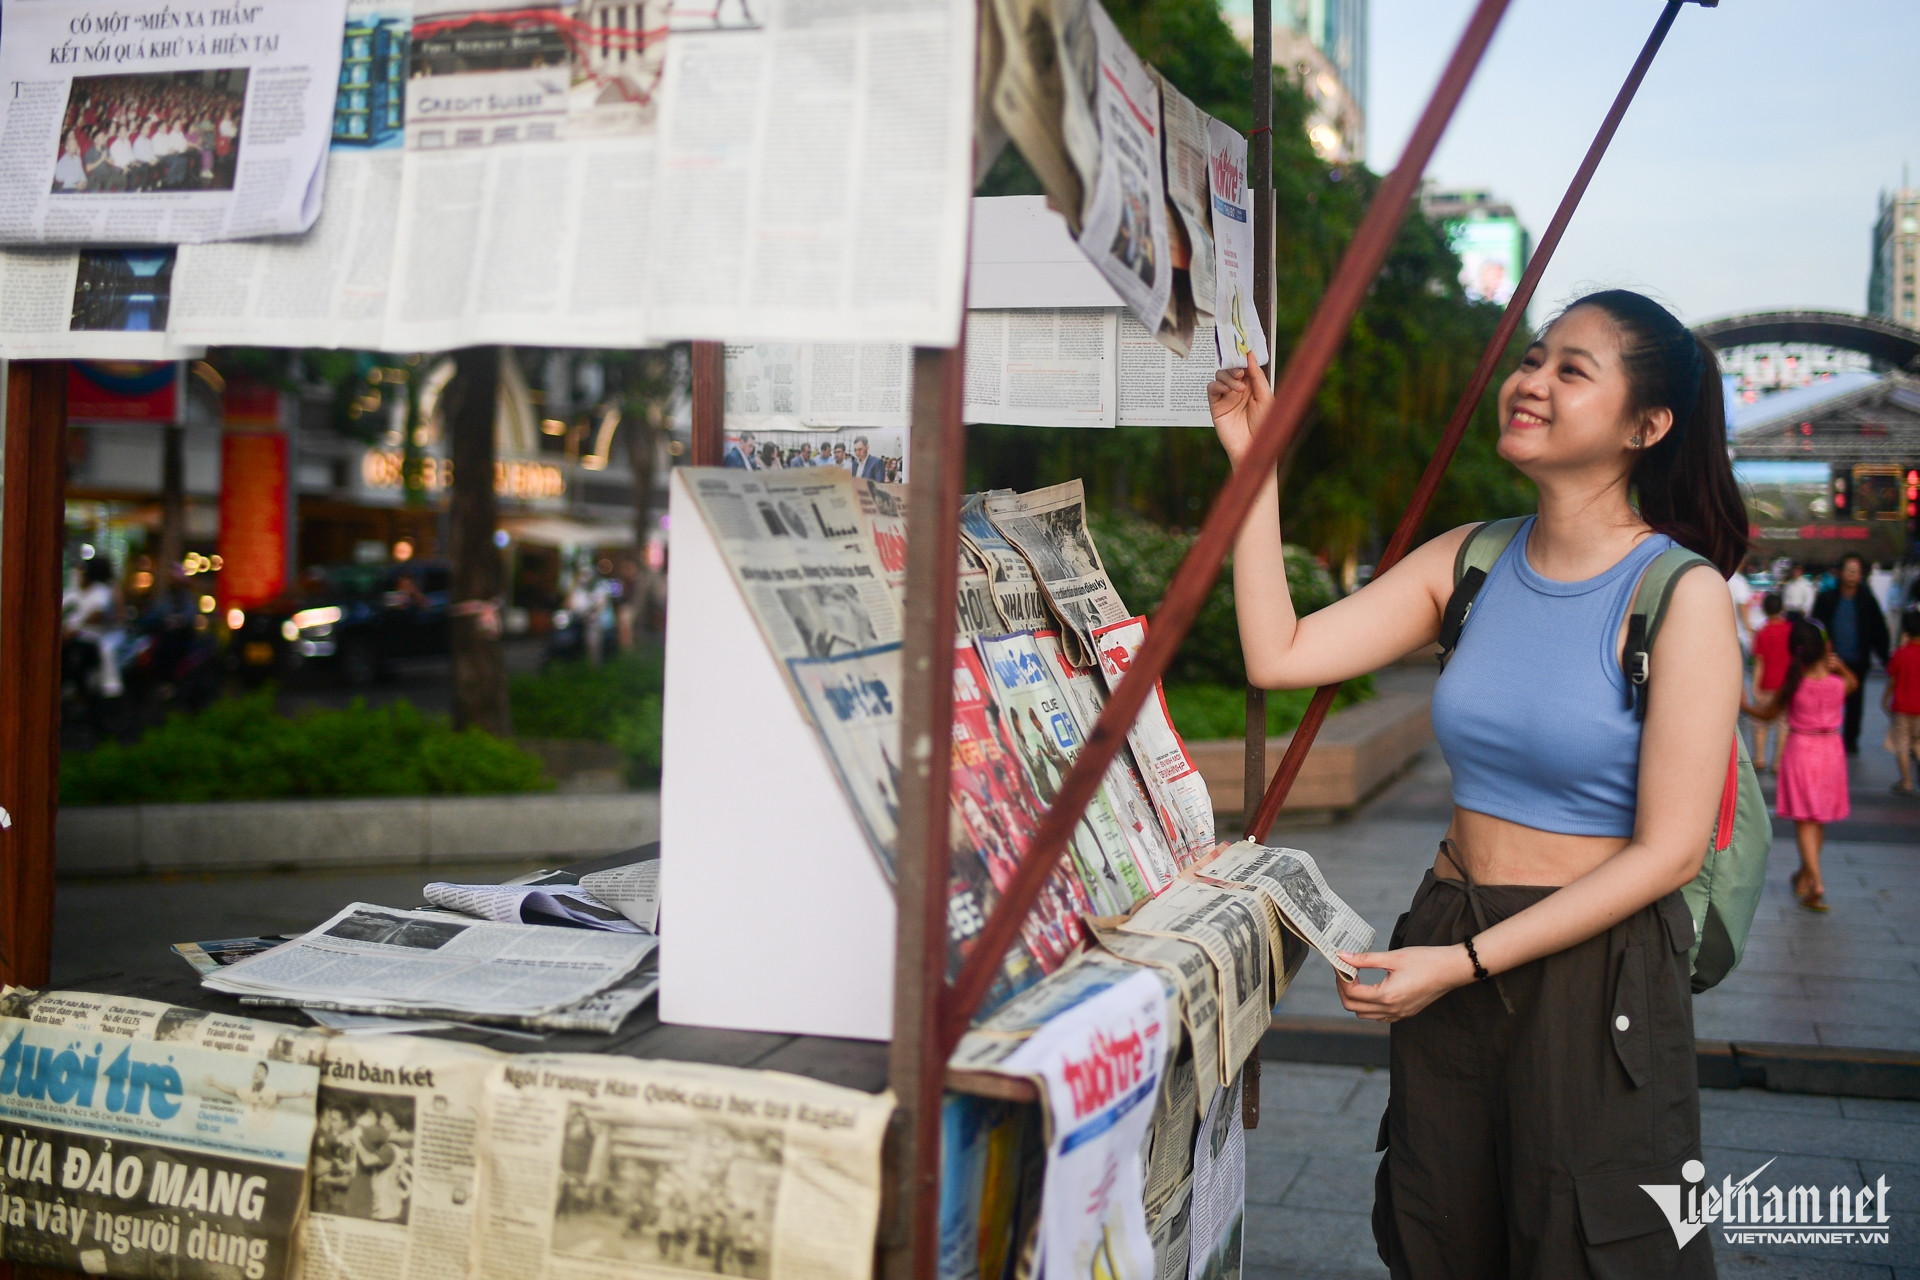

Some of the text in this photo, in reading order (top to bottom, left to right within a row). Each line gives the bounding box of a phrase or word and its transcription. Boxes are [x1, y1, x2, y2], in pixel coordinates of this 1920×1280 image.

[49, 39, 80, 64] KẾT
[83, 38, 111, 61] NỐI
[115, 39, 144, 62] QUÁ
[187, 35, 206, 55] VÀ
[212, 36, 248, 58] HIỆN
[252, 35, 280, 55] TẠI
[70, 15, 91, 35] CÓ
[95, 13, 131, 35] MỘT
[184, 11, 205, 29] XA
[62, 1138, 145, 1203] ĐẢO
[147, 1162, 269, 1222] MẠNG
[34, 1196, 88, 1247] vây
[95, 1210, 181, 1255] người
[186, 1216, 268, 1280] dùng
